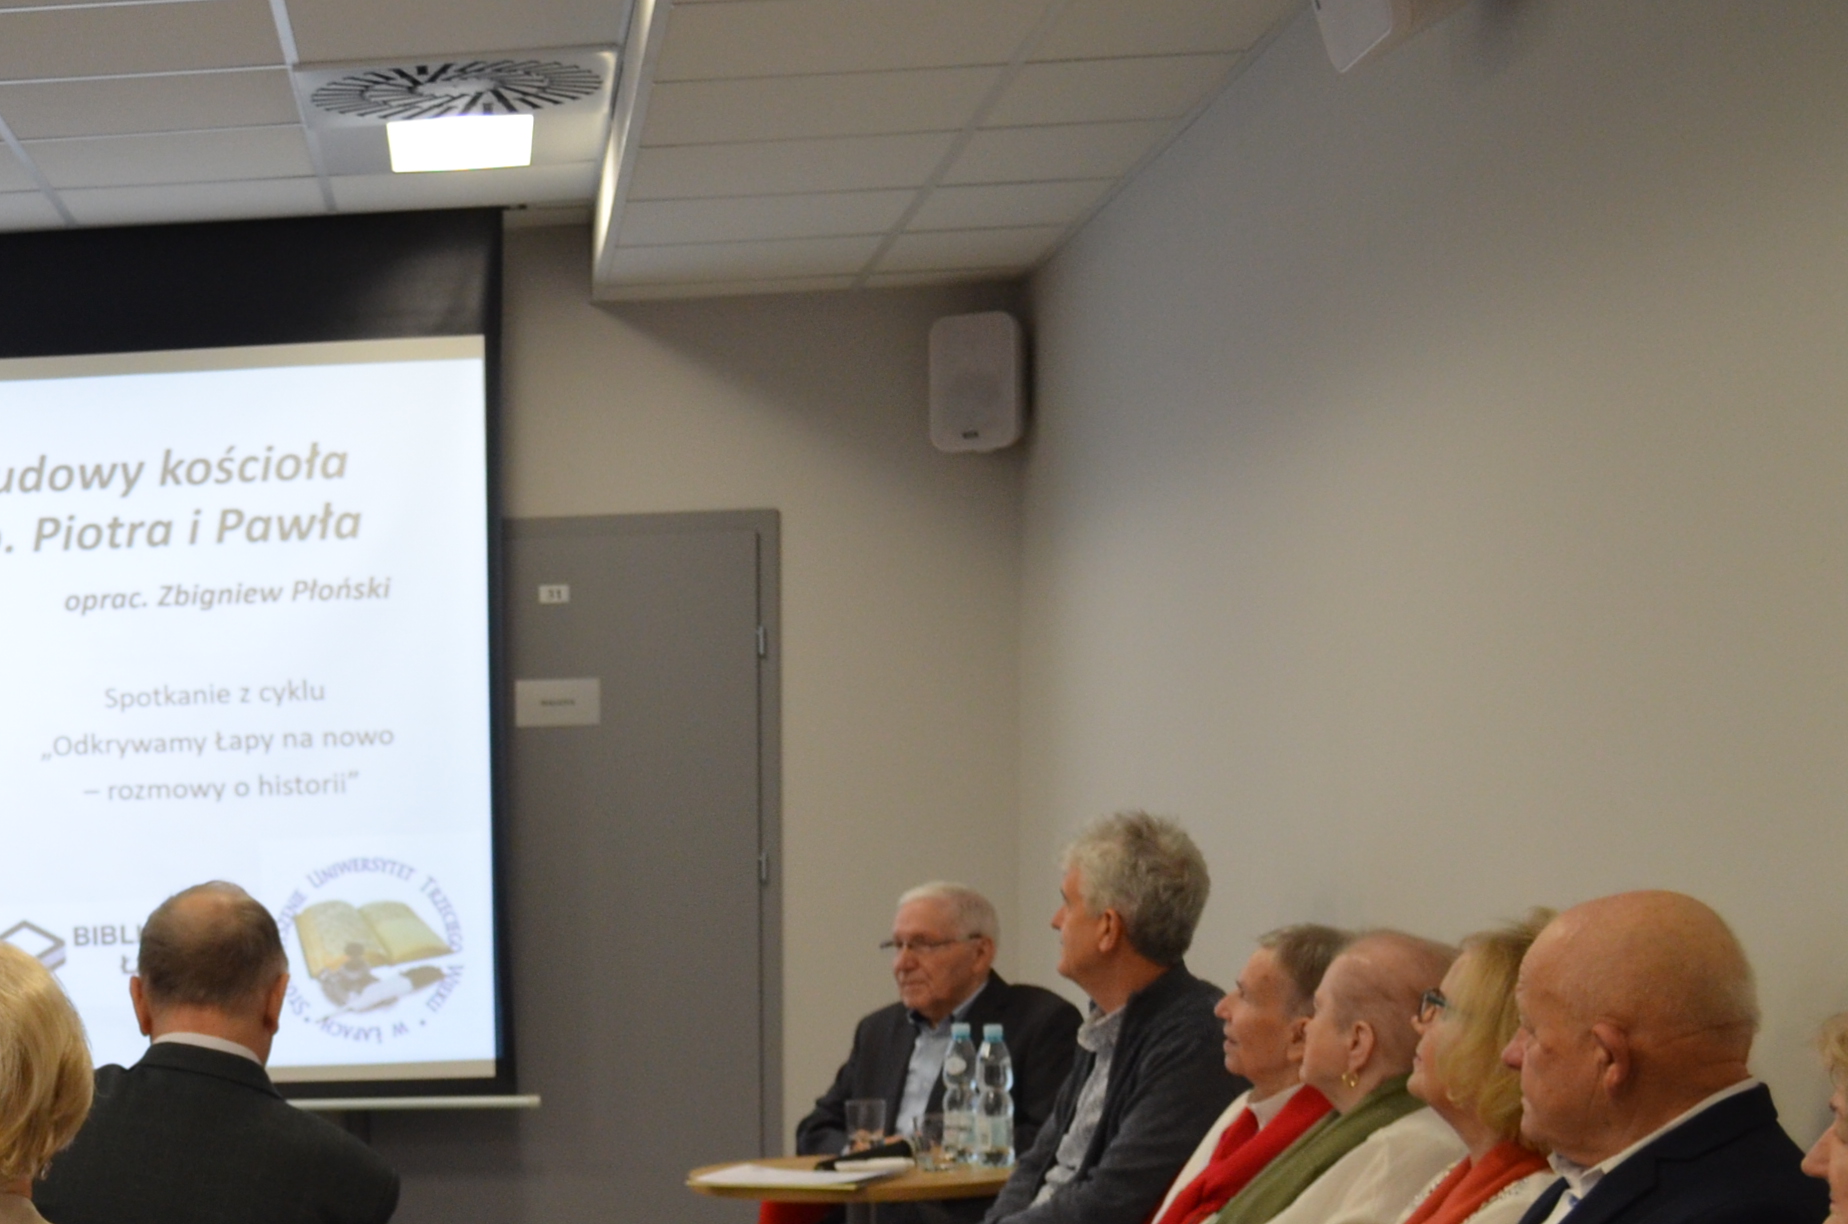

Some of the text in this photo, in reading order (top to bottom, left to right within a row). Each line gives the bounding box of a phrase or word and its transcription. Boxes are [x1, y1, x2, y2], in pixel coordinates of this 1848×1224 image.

[159, 441, 348, 488] kościoła
[33, 514, 174, 553] Piotra
[188, 508, 203, 546] i
[216, 501, 362, 545] Pawła
[63, 576, 392, 617] oprac. Zbigniew Płoński
[104, 678, 326, 714] Spotkanie z cyklu
[214, 730, 275, 755] Łapy
[282, 731, 315, 750] na
[322, 729, 396, 749] nowo
[107, 782, 227, 803] rozmowy
[233, 780, 251, 799] o
